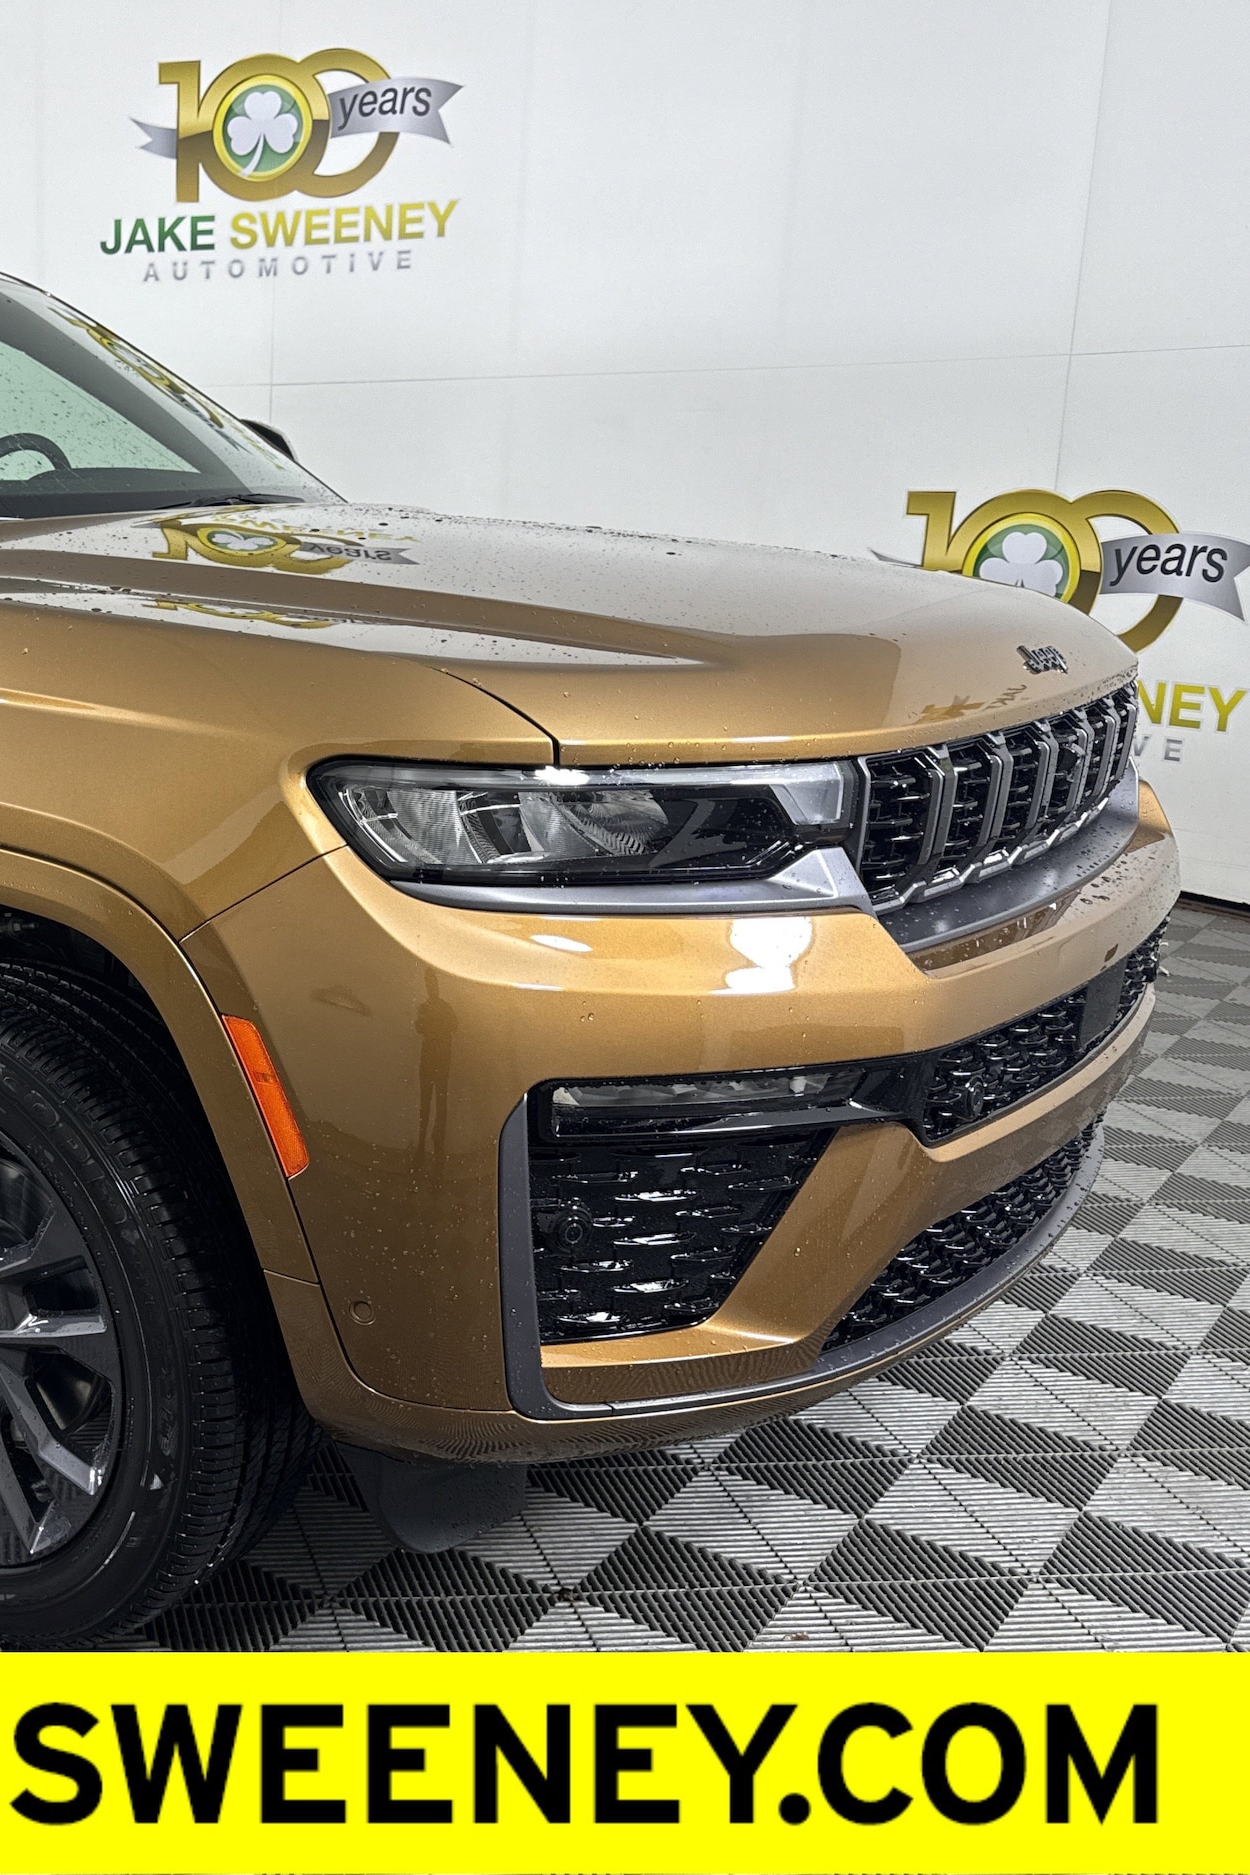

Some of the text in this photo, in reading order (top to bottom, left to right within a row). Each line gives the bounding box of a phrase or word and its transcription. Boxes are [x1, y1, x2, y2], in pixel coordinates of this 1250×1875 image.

[338, 85, 431, 131] years
[100, 199, 460, 255] JAKE SWEENEY
[143, 250, 412, 282] AUTOMOTIVE
[1109, 543, 1228, 587] years
